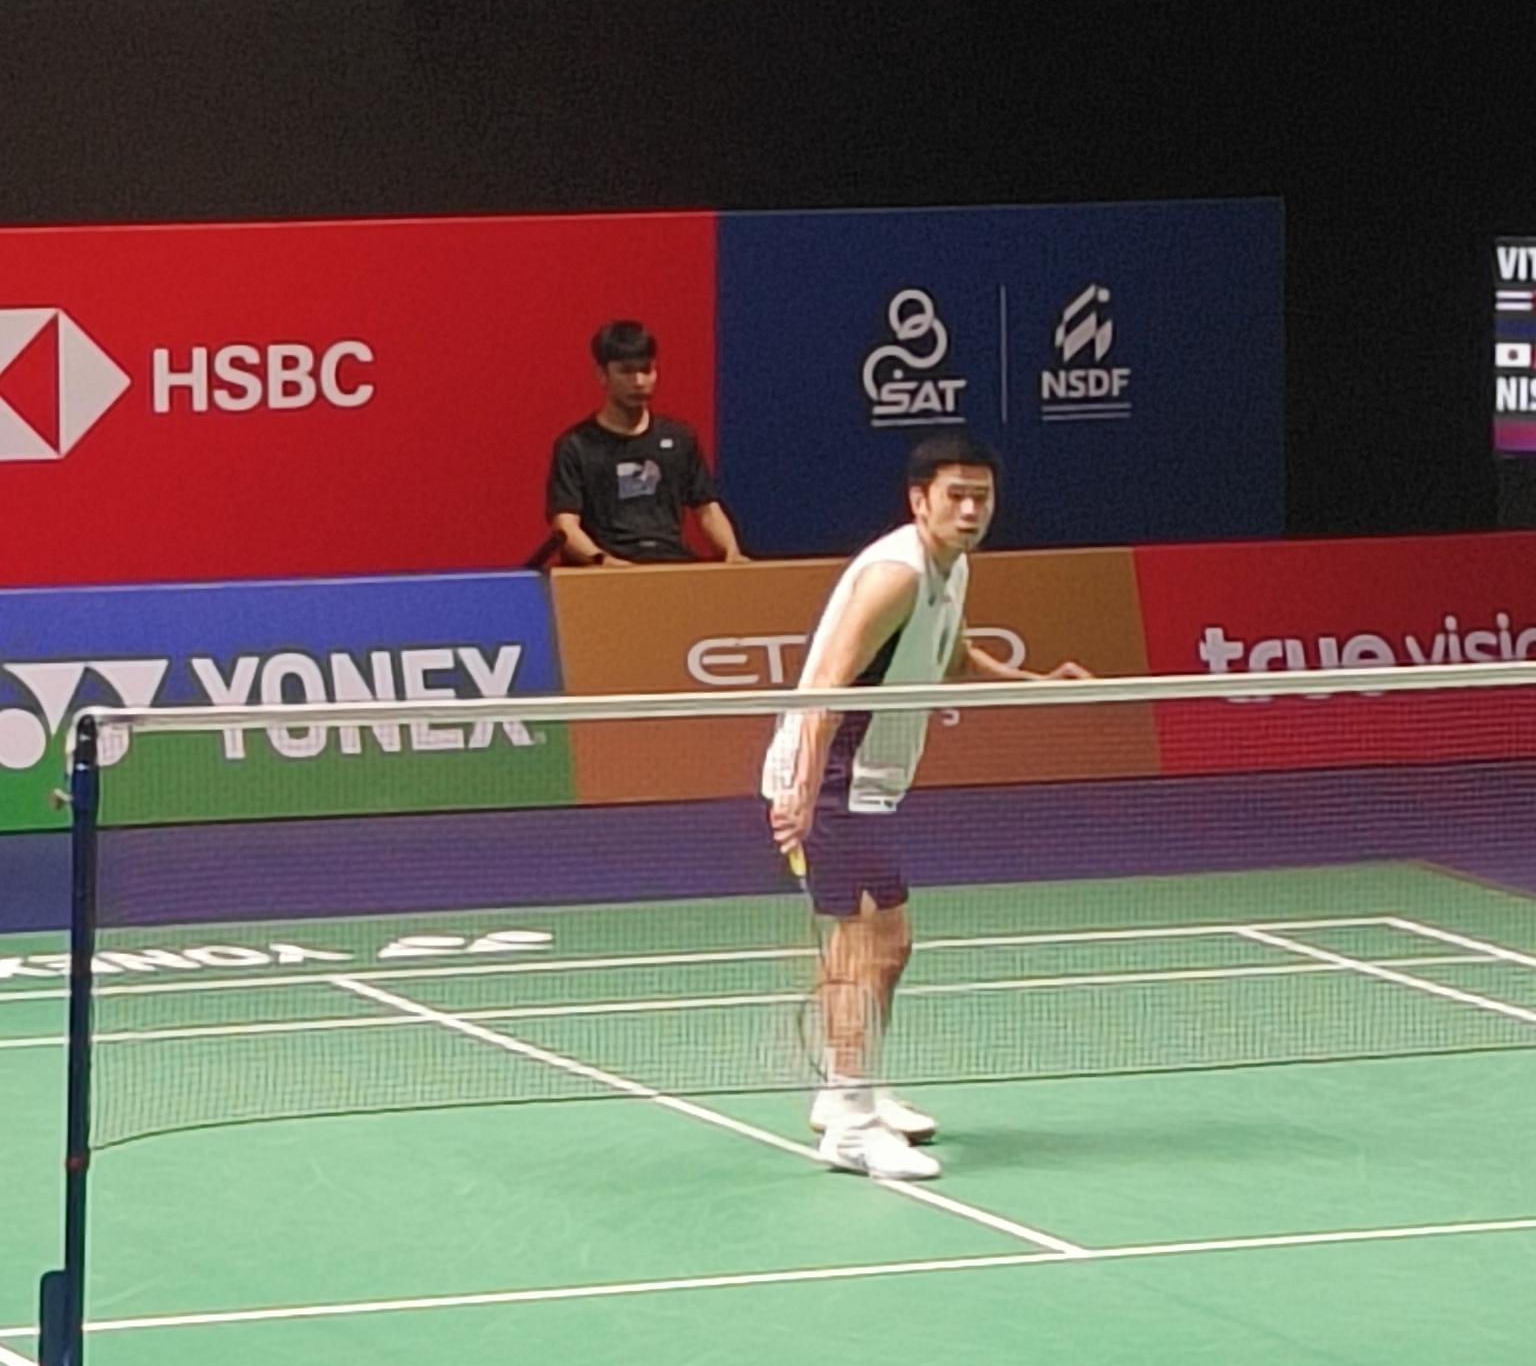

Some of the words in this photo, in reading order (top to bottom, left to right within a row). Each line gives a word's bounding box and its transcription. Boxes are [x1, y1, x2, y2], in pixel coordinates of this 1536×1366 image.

[153, 340, 374, 413] HSBC
[872, 379, 967, 415] SAT
[1041, 368, 1131, 399] NSDF
[191, 645, 535, 759] YONEX
[1199, 628, 1395, 703] true
